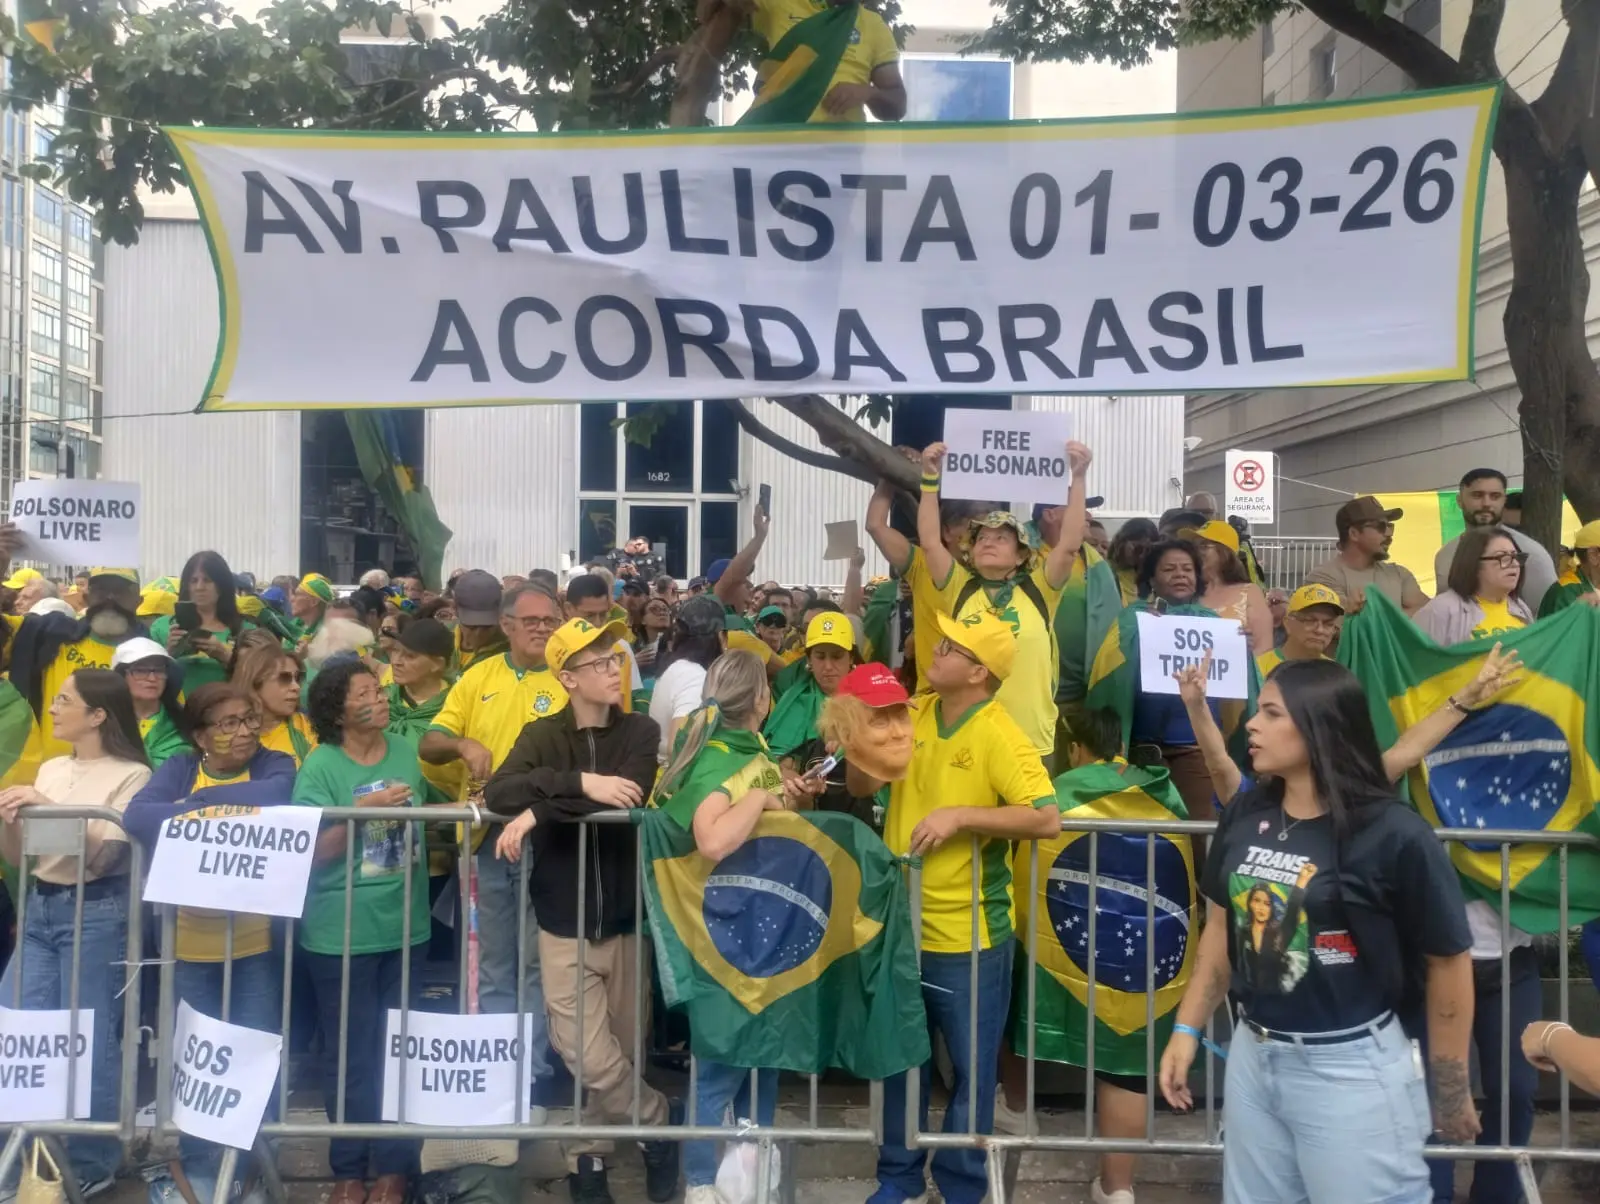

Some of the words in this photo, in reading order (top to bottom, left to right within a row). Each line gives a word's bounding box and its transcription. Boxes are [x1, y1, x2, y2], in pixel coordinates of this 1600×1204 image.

[242, 169, 400, 254] AV.
[416, 167, 978, 262] PAULISTA
[1009, 169, 1160, 260] 01-
[1193, 138, 1458, 248] 03-26
[410, 294, 908, 383] ACORDA
[921, 284, 1304, 383] BRASIL
[982, 429, 1031, 451] FREE
[647, 471, 670, 482] 1682
[946, 452, 1065, 478] BOLSONARO
[13, 497, 135, 519] BOLSONARO
[1227, 504, 1271, 512] SEGURANÇA
[39, 520, 101, 542] LIVRE
[1174, 628, 1214, 651] SOS
[165, 817, 311, 853] BOLSONARO
[198, 850, 268, 880] LIVRE
[1237, 863, 1254, 875] DE
[1245, 845, 1310, 873] TRANS
[1063, 870, 1106, 884] ORDM
[184, 1033, 233, 1075] SOS
[170, 1061, 242, 1118] TRUMP
[421, 1067, 486, 1093] LIVRE
